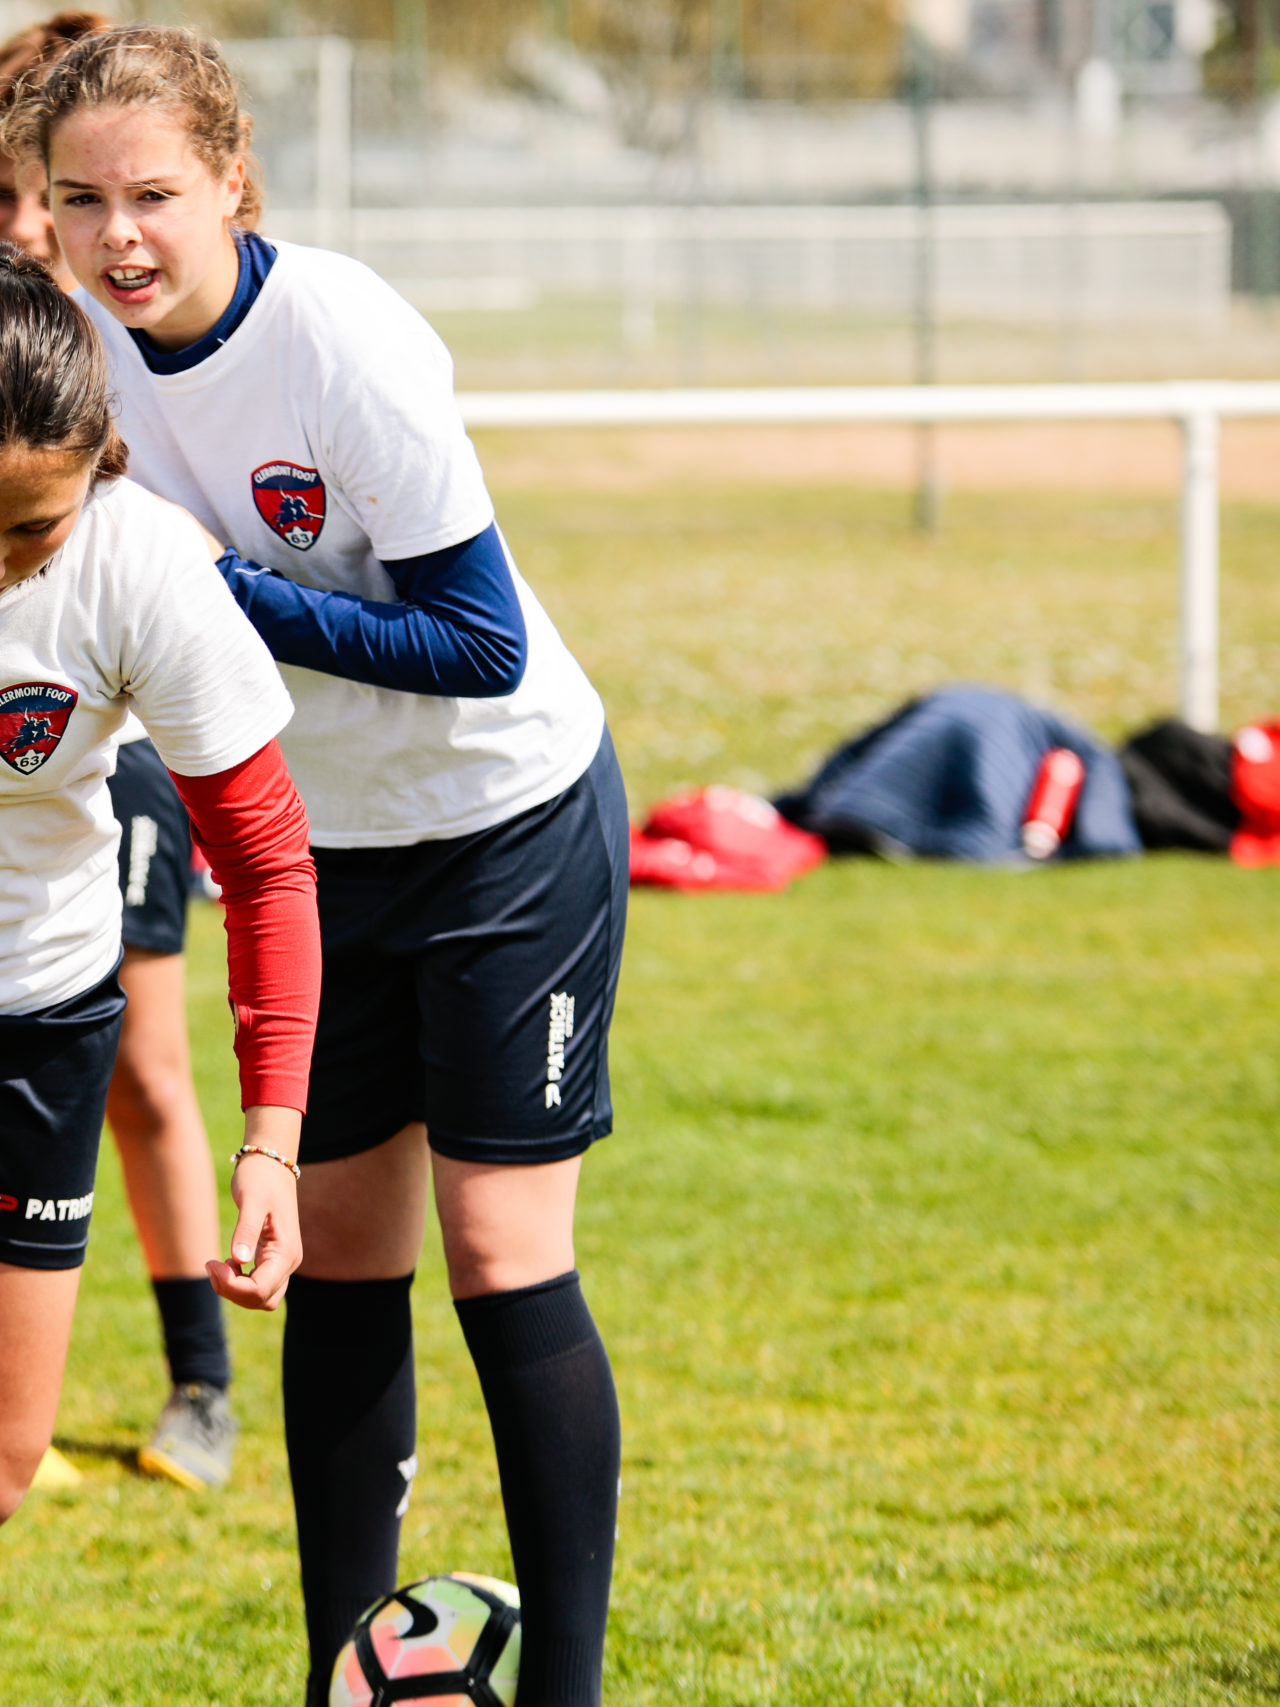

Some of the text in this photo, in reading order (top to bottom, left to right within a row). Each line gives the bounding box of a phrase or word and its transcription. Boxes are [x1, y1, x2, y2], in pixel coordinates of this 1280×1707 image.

[292, 468, 317, 483] FOOT
[291, 533, 309, 543] 63
[45, 687, 72, 703] FOOT
[20, 755, 40, 767] 63
[547, 991, 567, 1081] PATRICK
[25, 1192, 95, 1221] PATRIC
